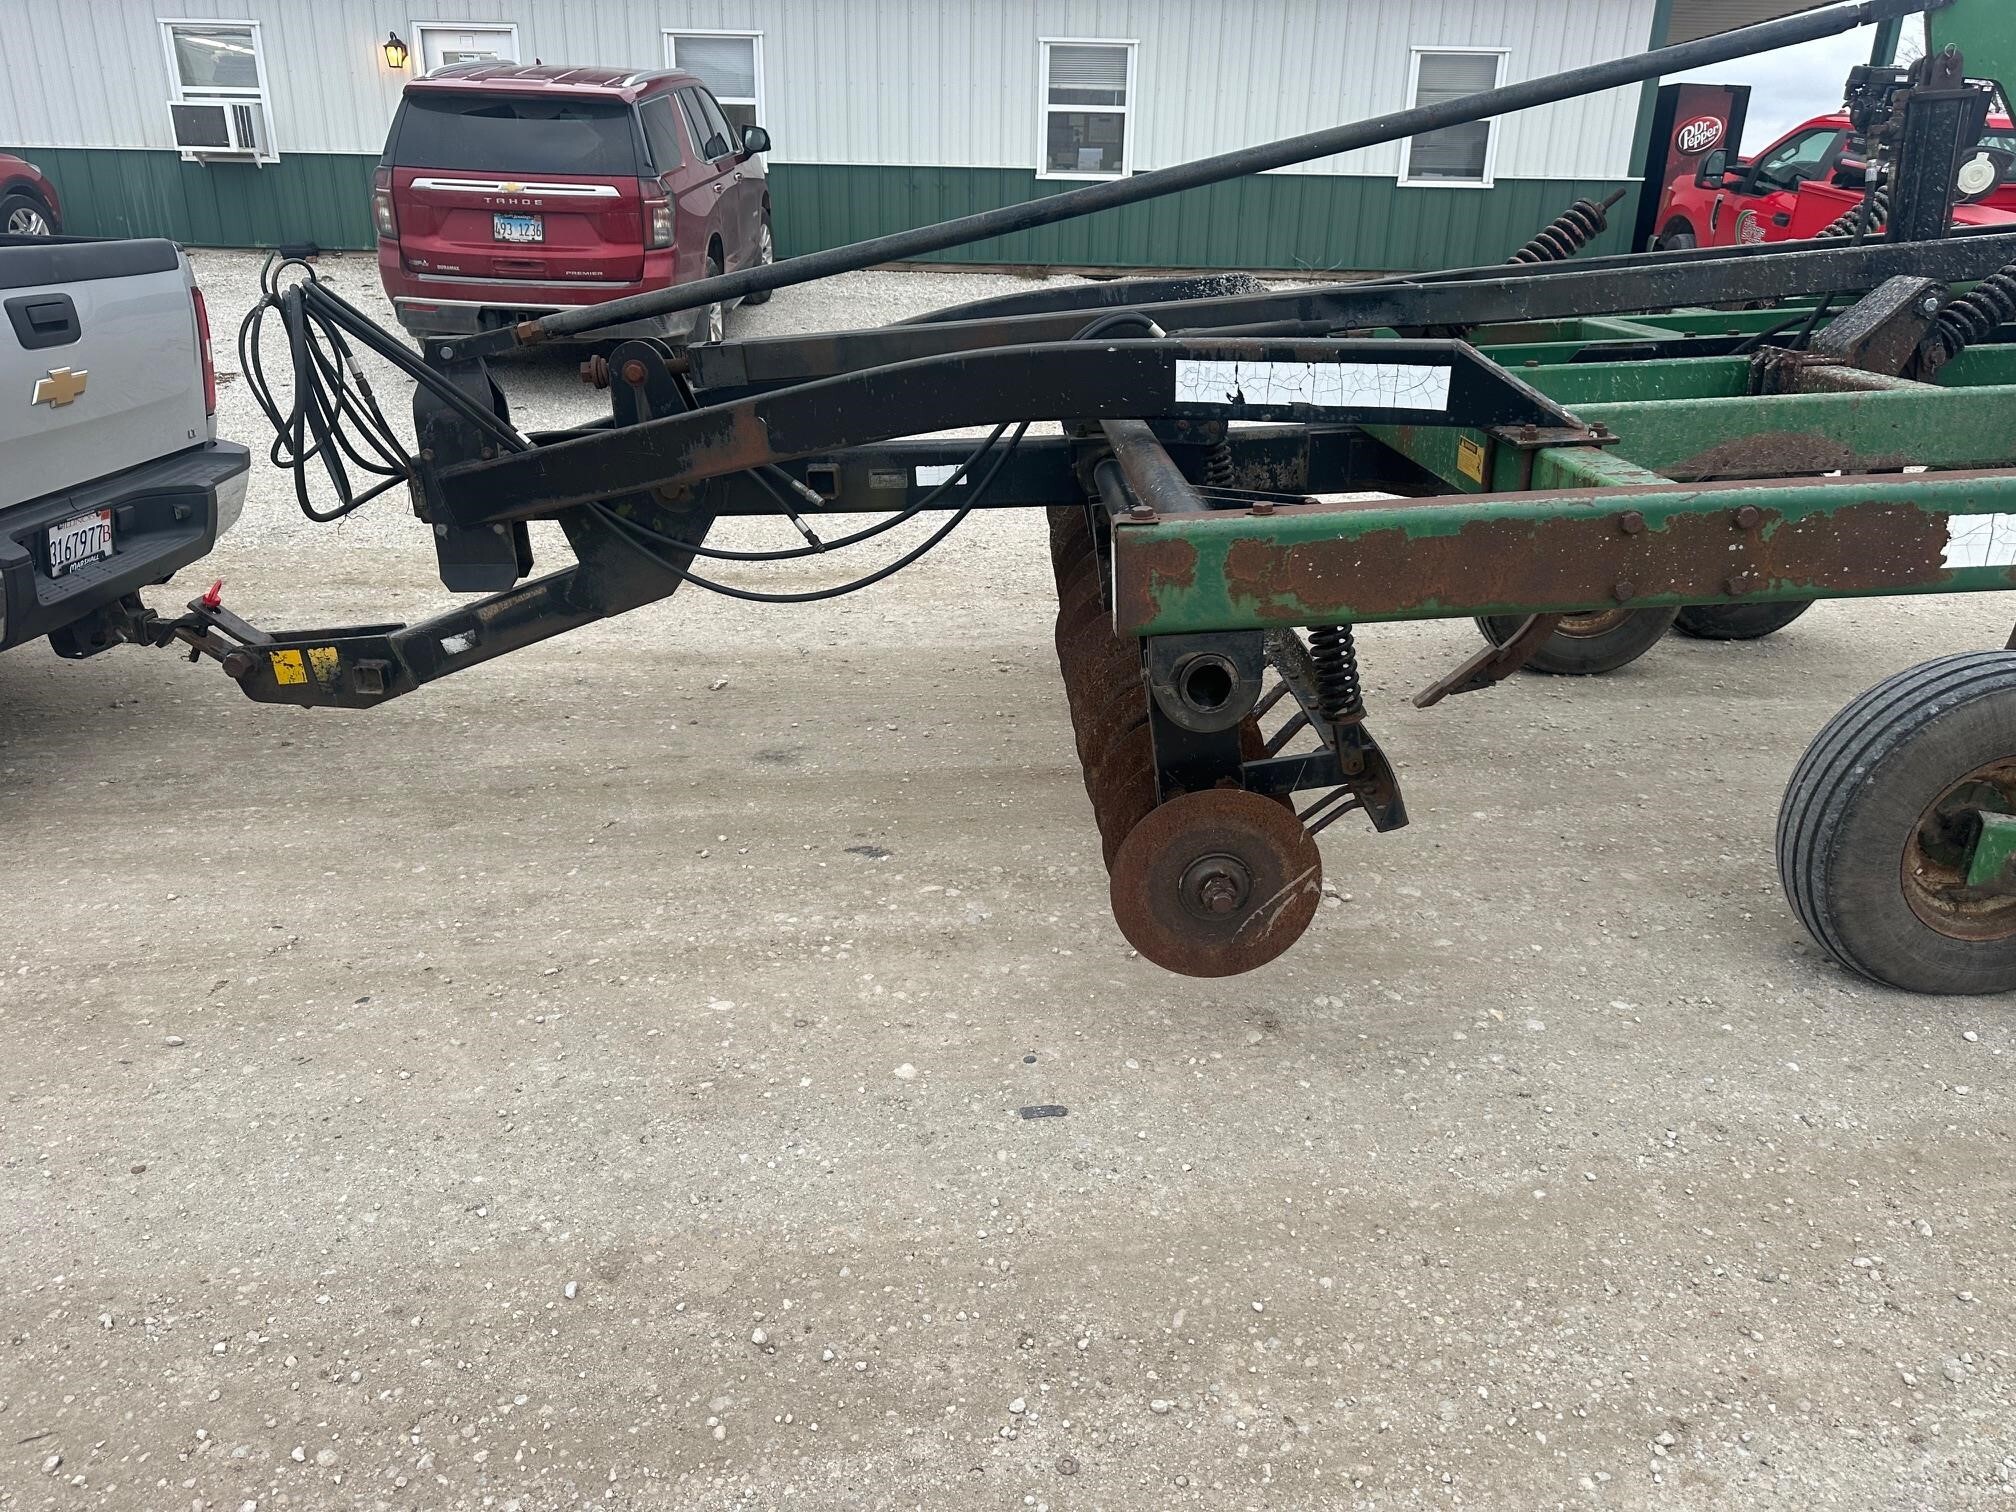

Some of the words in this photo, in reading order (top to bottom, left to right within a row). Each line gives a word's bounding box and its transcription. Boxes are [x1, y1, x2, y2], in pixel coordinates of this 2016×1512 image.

[1694, 121, 1710, 136] Dr
[1678, 125, 1719, 150] Pepper
[483, 197, 543, 206] TAHOE
[495, 222, 512, 236] 493
[519, 224, 542, 237] 1236
[50, 524, 103, 568] 3167977
[102, 524, 111, 543] B
